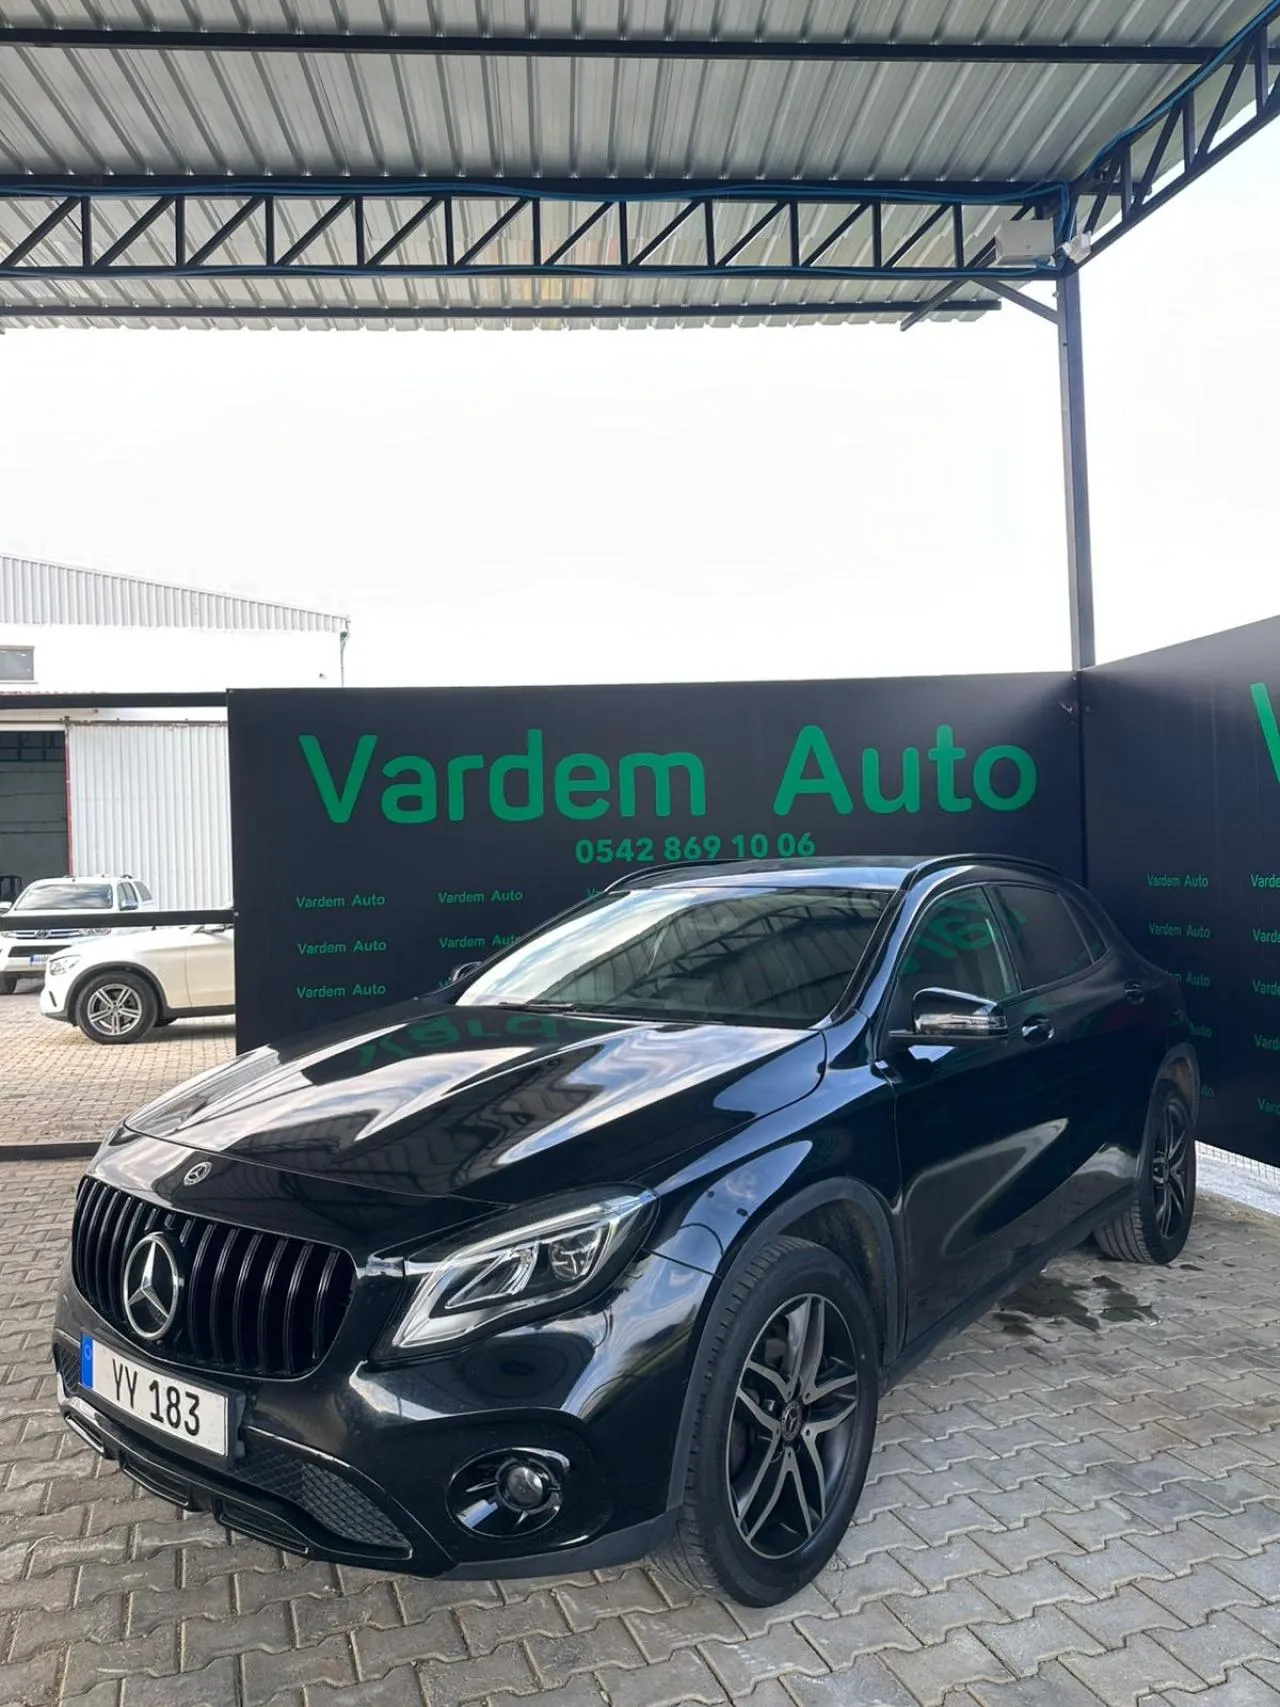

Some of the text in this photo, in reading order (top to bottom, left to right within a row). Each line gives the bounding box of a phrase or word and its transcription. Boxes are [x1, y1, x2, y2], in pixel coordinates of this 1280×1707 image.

[299, 724, 1037, 824] Vardem Auto
[575, 832, 816, 864] 0542 869 10 06
[1147, 873, 1209, 888] Vardem Auto
[1250, 874, 1280, 888] Varde
[296, 894, 386, 908] Vardem Auto
[437, 890, 524, 904] Vardem Auto
[1148, 922, 1211, 938] Vardem Auto
[298, 940, 387, 955] Vardem Auto
[438, 934, 519, 949] Vardem Aut
[1186, 972, 1211, 987] Auto
[296, 984, 386, 999] Vardem Auto
[1254, 1034, 1280, 1050] Vard
[112, 1358, 200, 1436] YY 183
